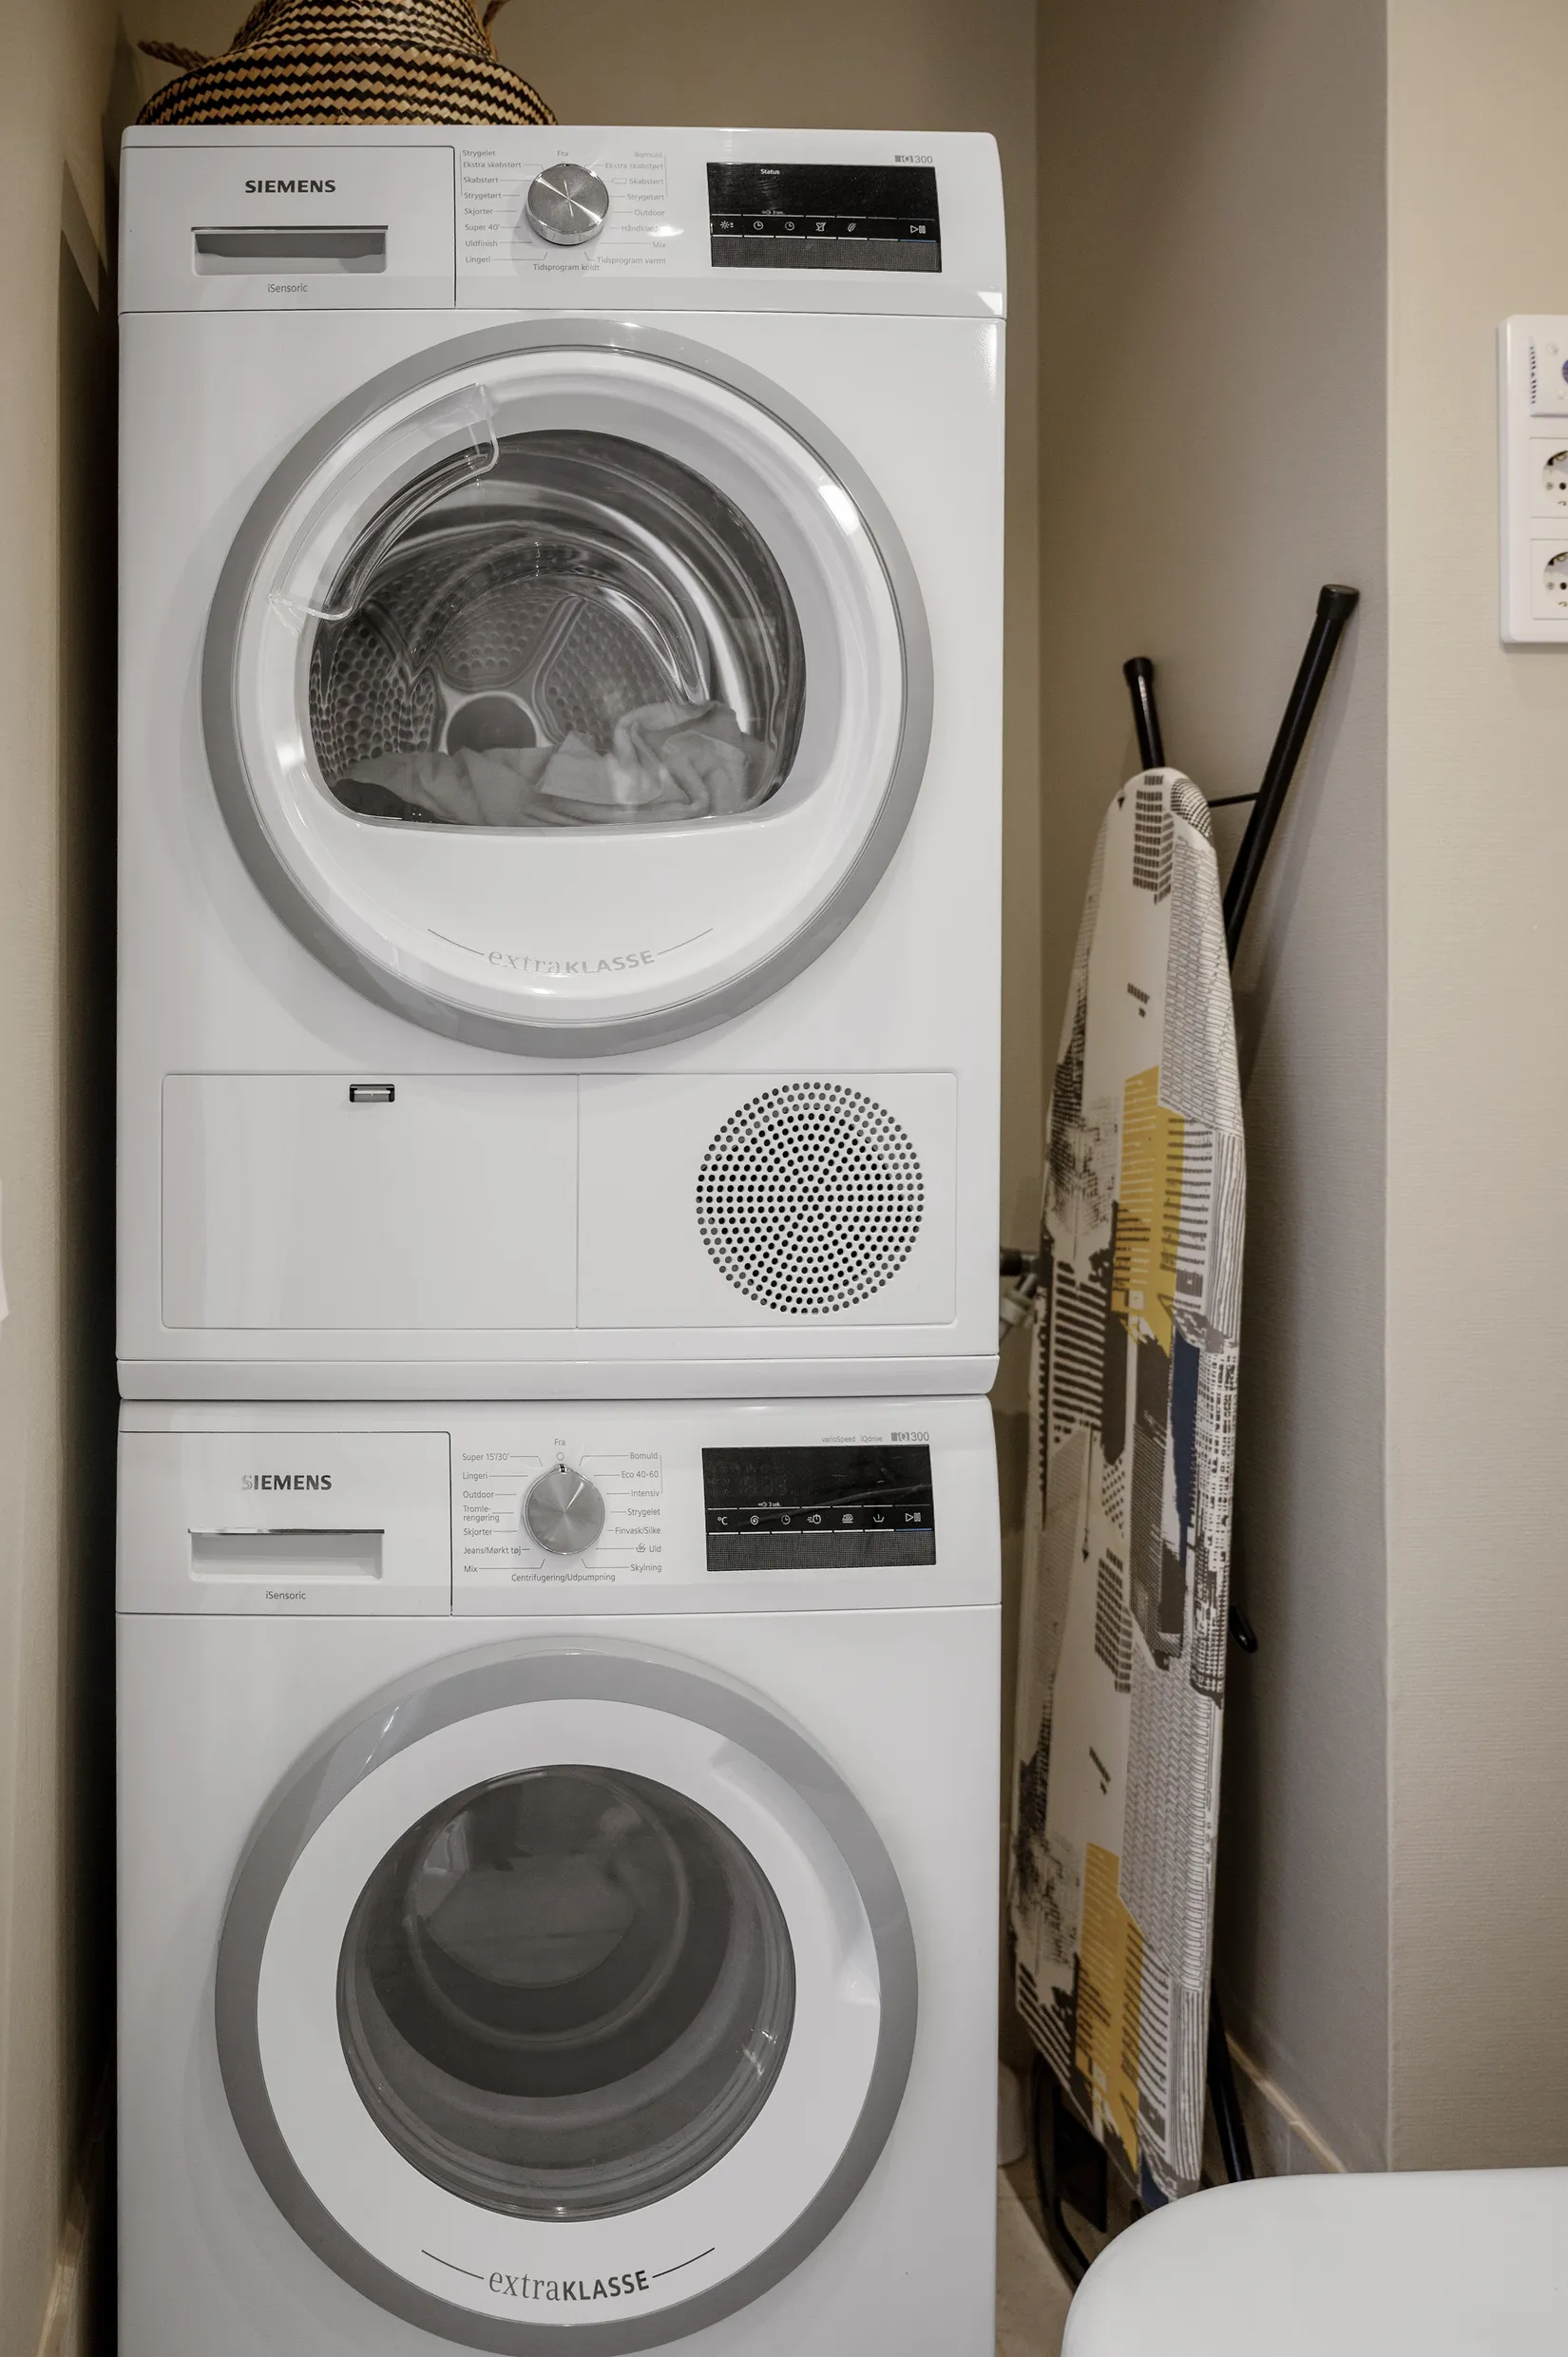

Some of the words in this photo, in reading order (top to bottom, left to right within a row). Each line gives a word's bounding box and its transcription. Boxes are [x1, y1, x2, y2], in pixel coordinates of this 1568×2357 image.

[628, 177, 665, 185] Skabstørt
[244, 180, 336, 193] SIEMENS
[464, 192, 502, 201] Strygetørt
[627, 193, 665, 201] Strygetørt
[465, 207, 493, 216] Skjorter
[634, 208, 665, 217] Outdoor
[465, 223, 486, 232] Super
[465, 256, 491, 264] Lingeri
[597, 256, 642, 266] Tidsprogram
[533, 263, 580, 273] Tidsprogram
[267, 283, 308, 293] iSensoric
[488, 949, 655, 974] extraKLASSE
[554, 1438, 566, 1447] Fra
[462, 1453, 483, 1462] Super
[462, 1472, 488, 1481] Lingeri
[636, 1470, 659, 1479] 40-60
[241, 1475, 333, 1490] SIEMENS
[627, 1508, 660, 1517] Strygelet
[463, 1514, 500, 1523] rengøring
[463, 1527, 493, 1536] Skjorter
[615, 1526, 661, 1535] Finvask/Silke
[463, 1546, 509, 1555] Jeans/Mørkt
[510, 1546, 522, 1556] tøj
[630, 1563, 662, 1573] Skylning
[511, 1574, 616, 1582] Centrifugering/Udpumpning
[265, 1591, 307, 1600] iSensoric
[488, 2270, 650, 2301] extraKLASSE
